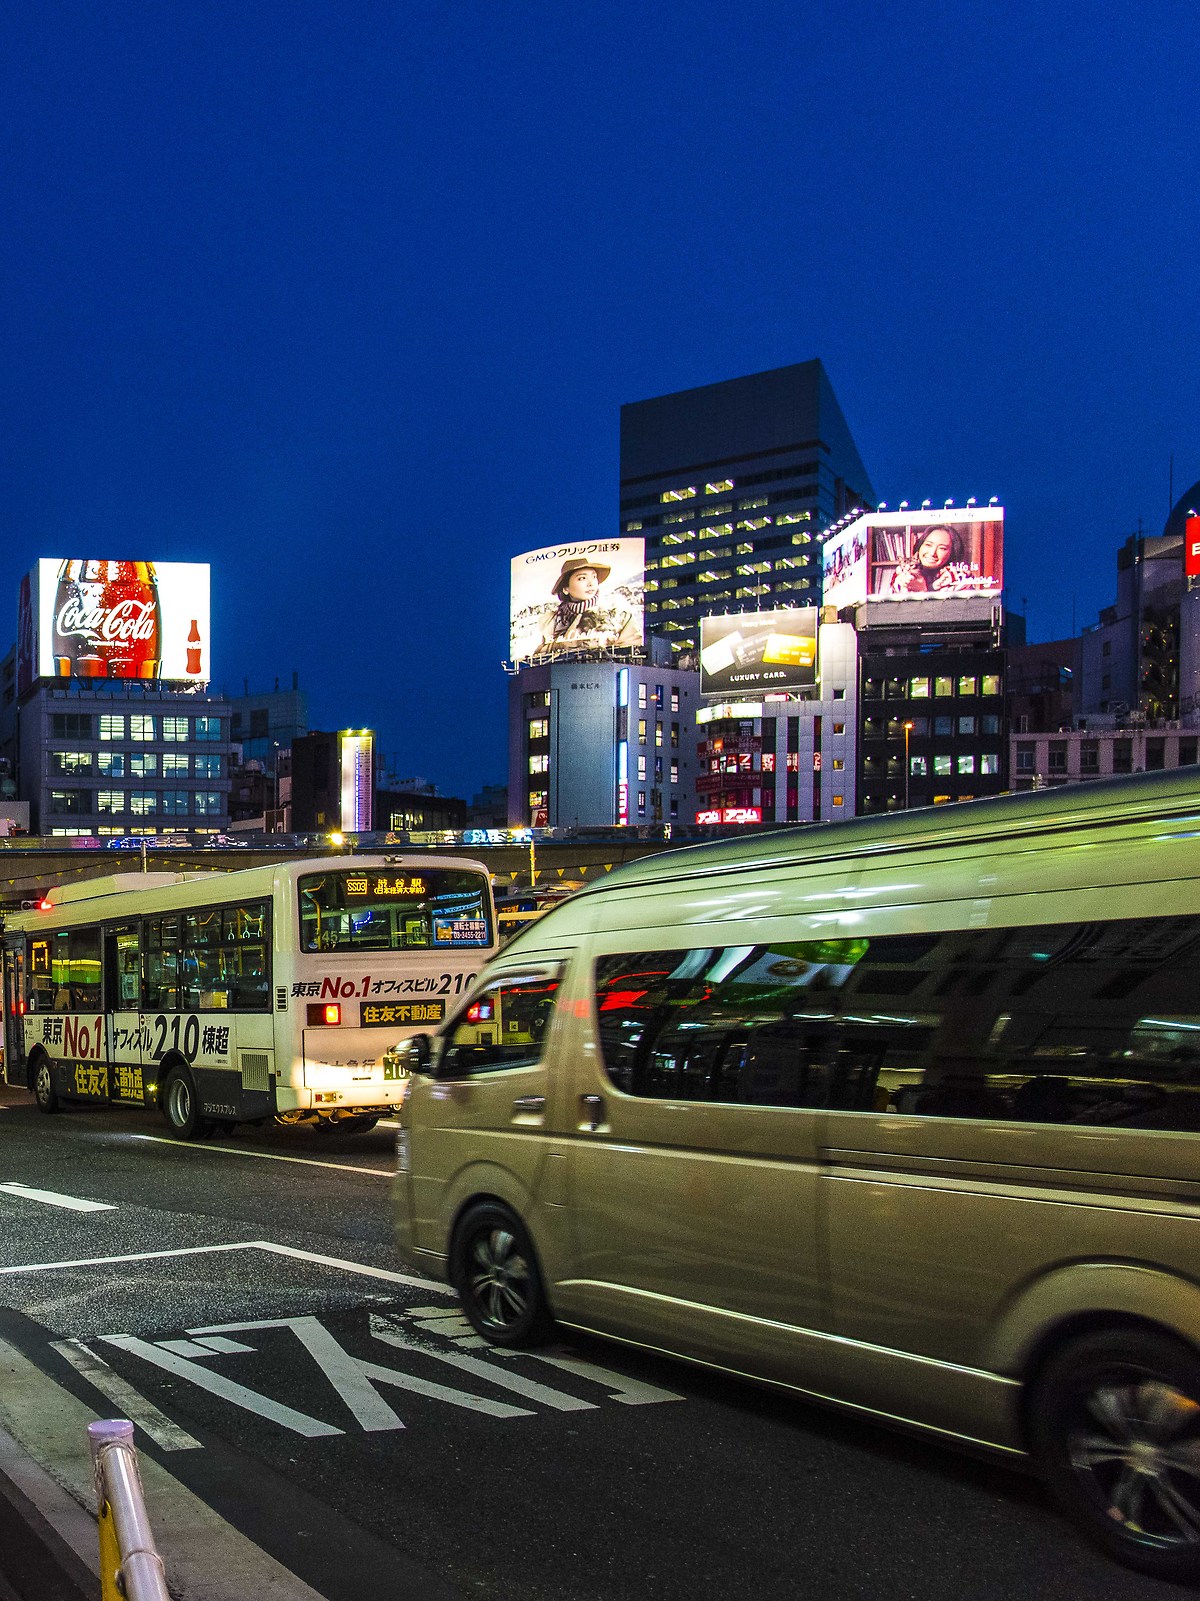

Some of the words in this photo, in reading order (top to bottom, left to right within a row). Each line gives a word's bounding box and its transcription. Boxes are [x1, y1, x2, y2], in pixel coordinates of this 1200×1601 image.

[57, 598, 156, 641] Coca-Cola
[730, 673, 760, 682] LUXURY
[348, 882, 366, 892] SS03
[377, 879, 422, 888] 渋谷駅
[363, 1003, 442, 1024] 住友不動産
